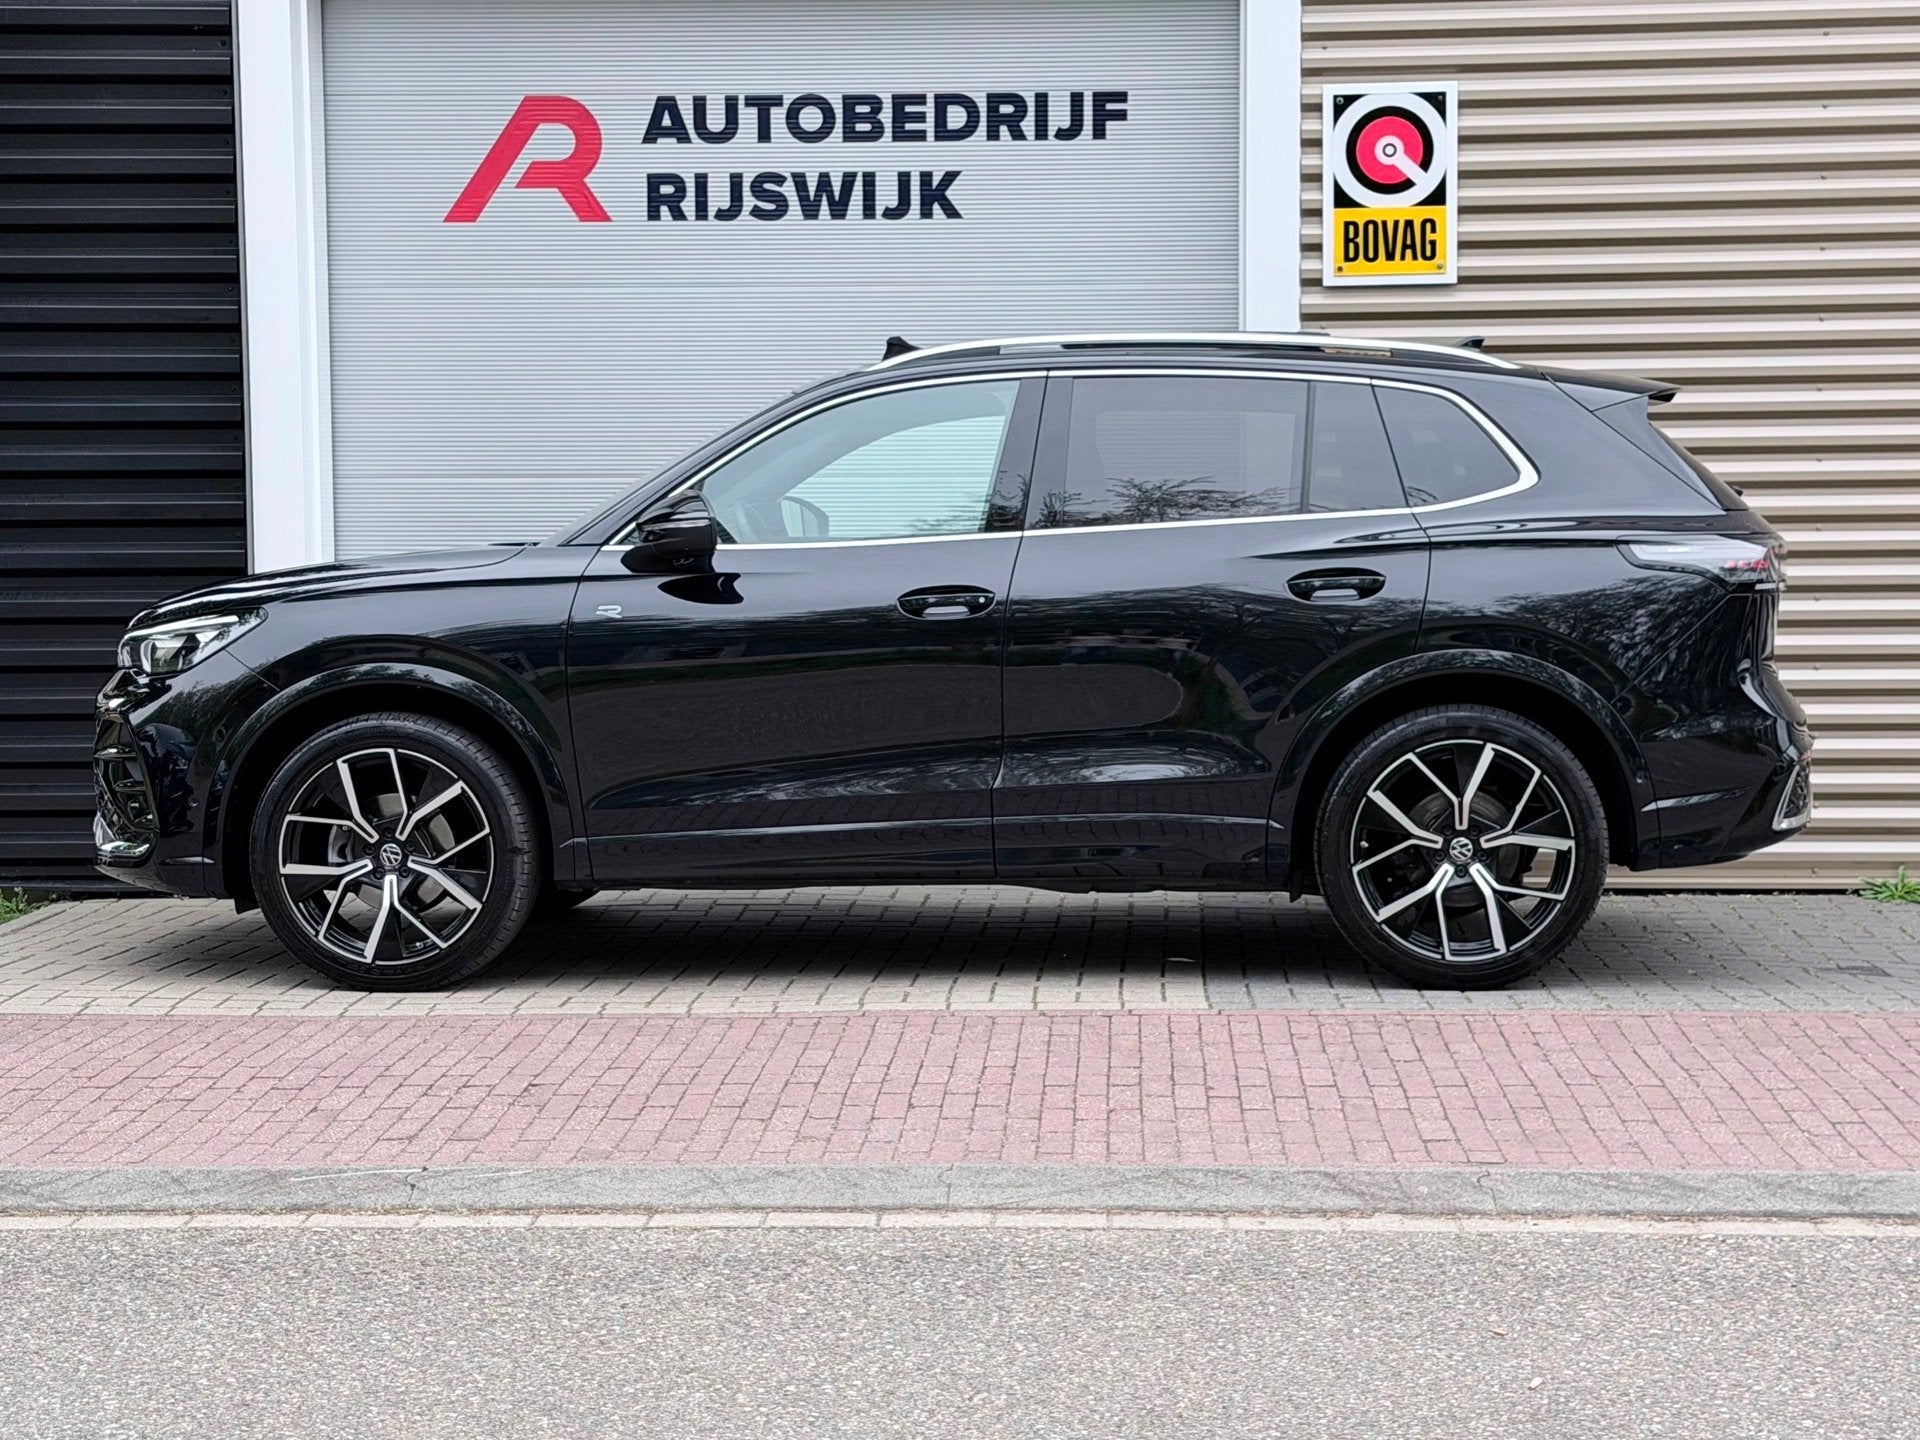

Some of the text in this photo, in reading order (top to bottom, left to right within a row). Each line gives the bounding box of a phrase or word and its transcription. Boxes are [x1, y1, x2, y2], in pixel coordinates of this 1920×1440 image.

[642, 91, 1129, 144] AUTOBEDRIJF
[646, 170, 964, 222] RIJSWIJK
[1343, 218, 1437, 263] BOVAG
